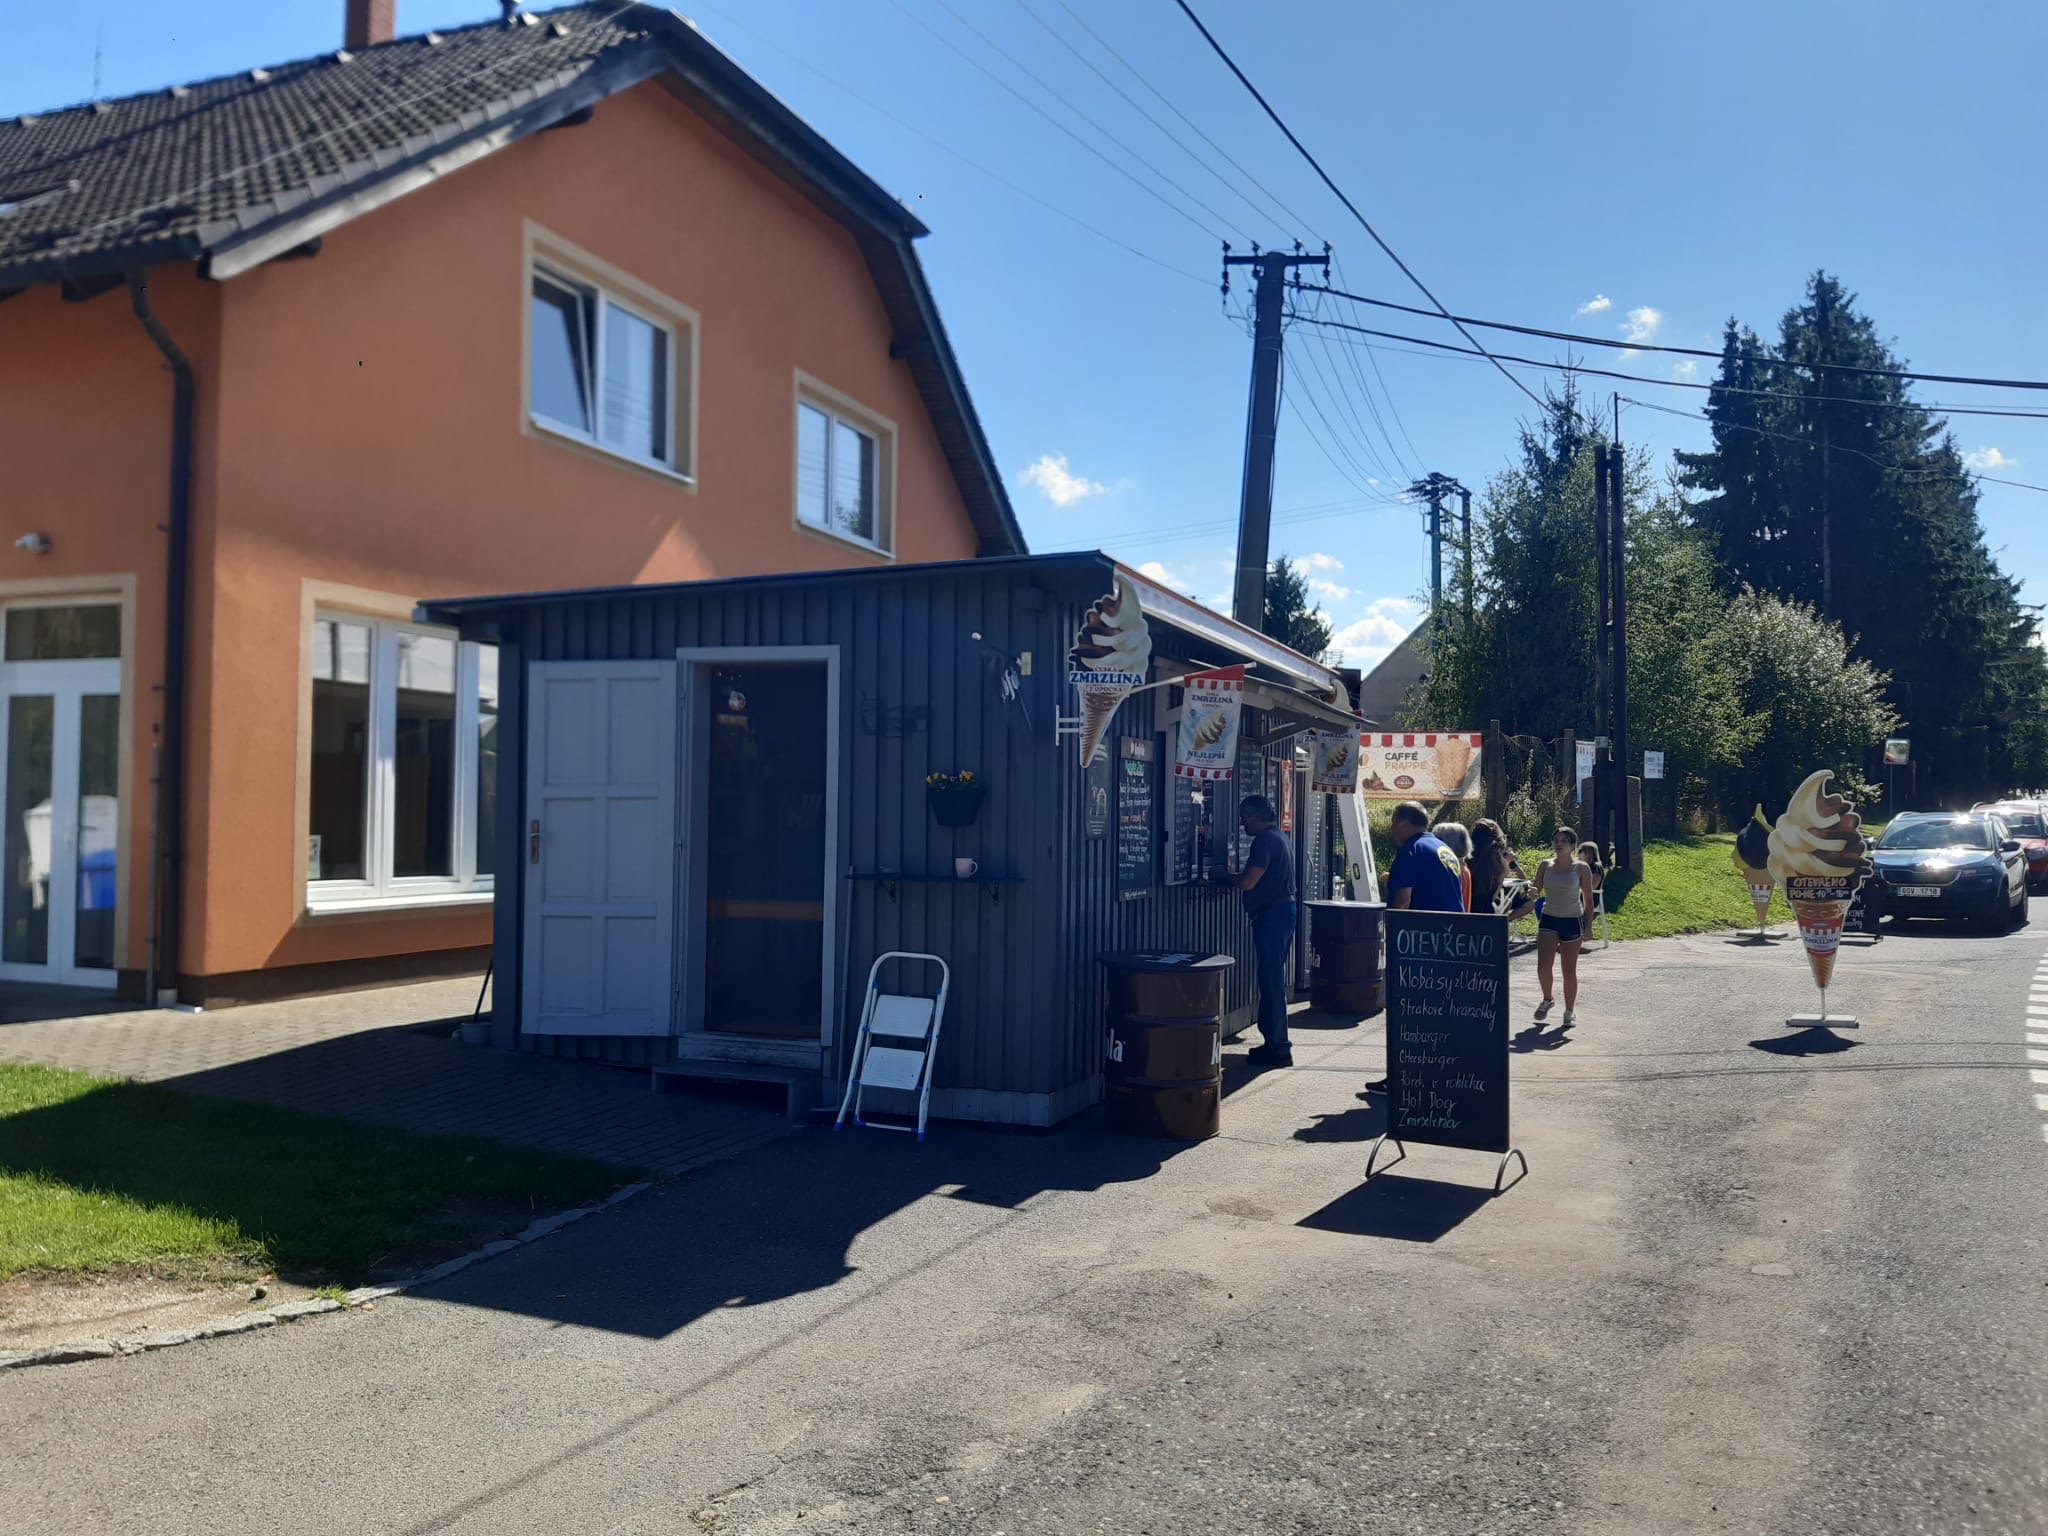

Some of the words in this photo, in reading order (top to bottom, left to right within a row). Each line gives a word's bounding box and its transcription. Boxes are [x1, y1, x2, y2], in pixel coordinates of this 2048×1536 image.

[1070, 672, 1143, 684] ZMRZLINA
[1191, 694, 1233, 704] ZMRZLINA
[1397, 924, 1493, 957] OTEVŘENO
[1399, 965, 1453, 999] Klobásy
[1399, 1023, 1451, 1051] Hamburger
[1402, 1089, 1422, 1108] Hot
[1428, 1090, 1457, 1117] Dog
[1398, 1107, 1462, 1130] Zmrzlina
